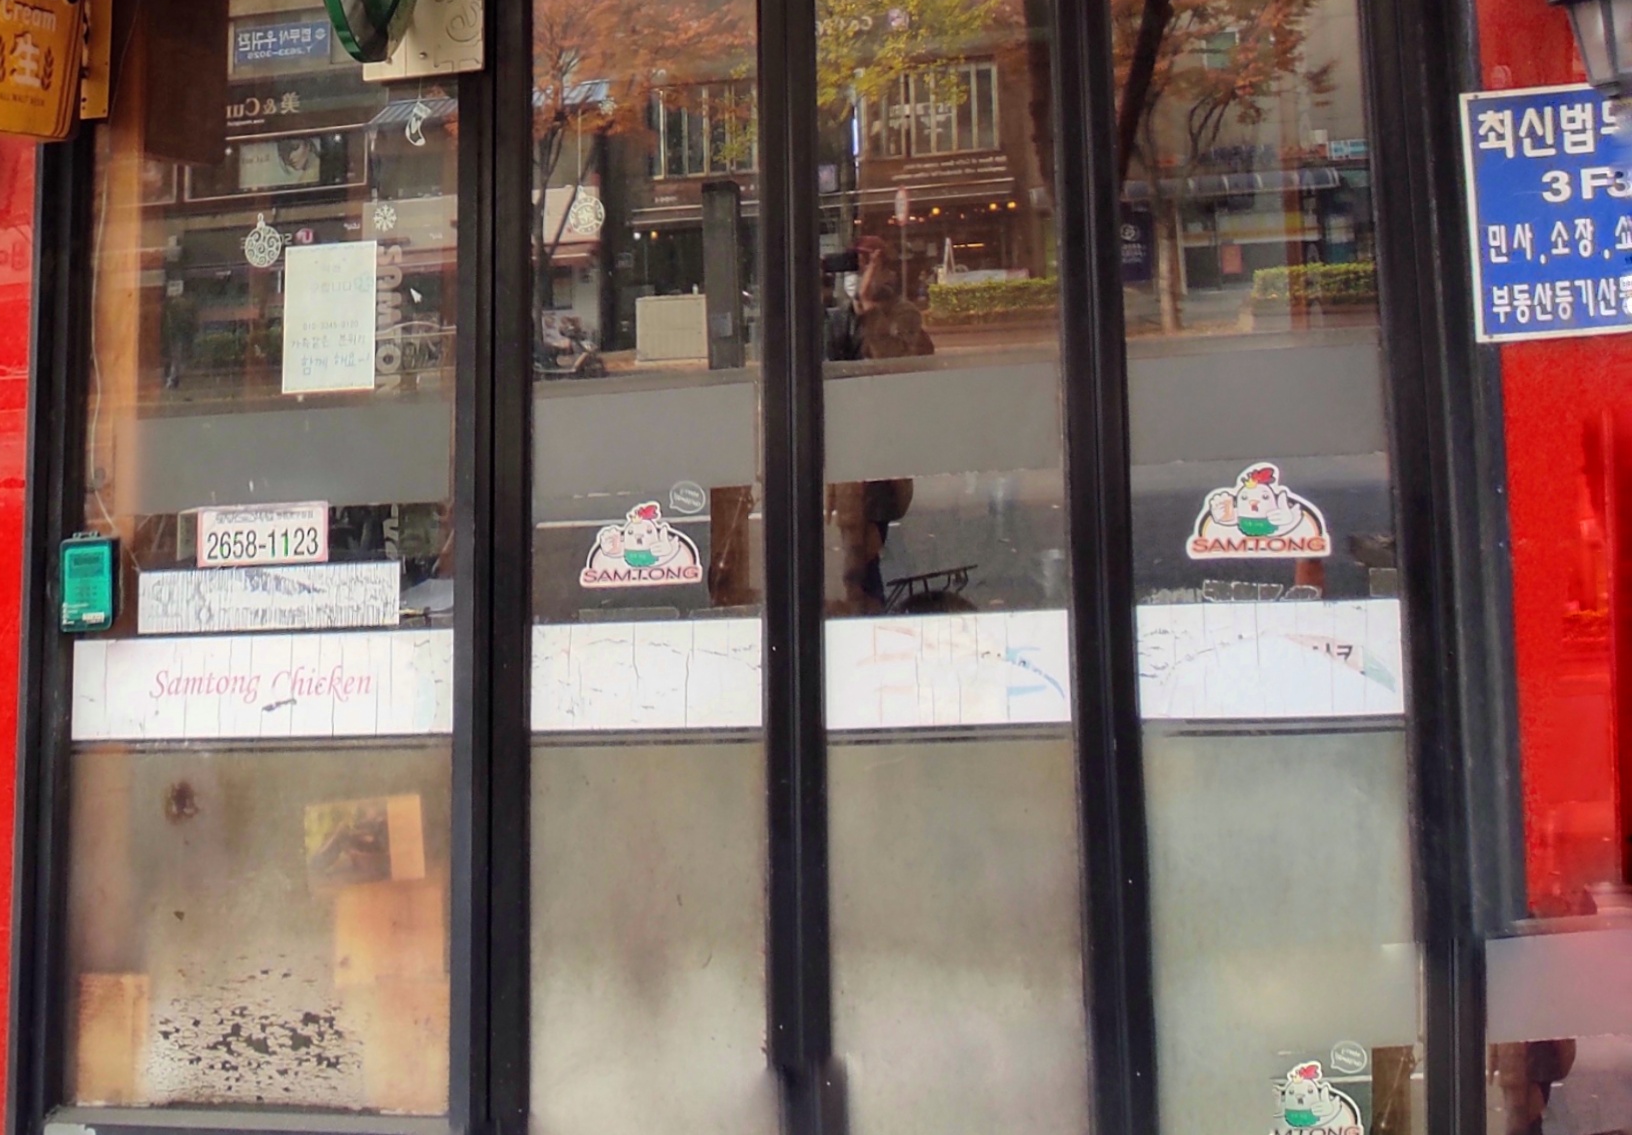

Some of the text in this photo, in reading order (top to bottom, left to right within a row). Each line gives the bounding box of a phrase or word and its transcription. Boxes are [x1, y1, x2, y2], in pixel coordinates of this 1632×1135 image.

[10, 31, 43, 88] 生
[206, 527, 319, 561] 2658-1123
[1192, 536, 1326, 553] SAMTONG
[582, 565, 700, 583] SAMTONG
[149, 665, 372, 703] Samtong Chicken
